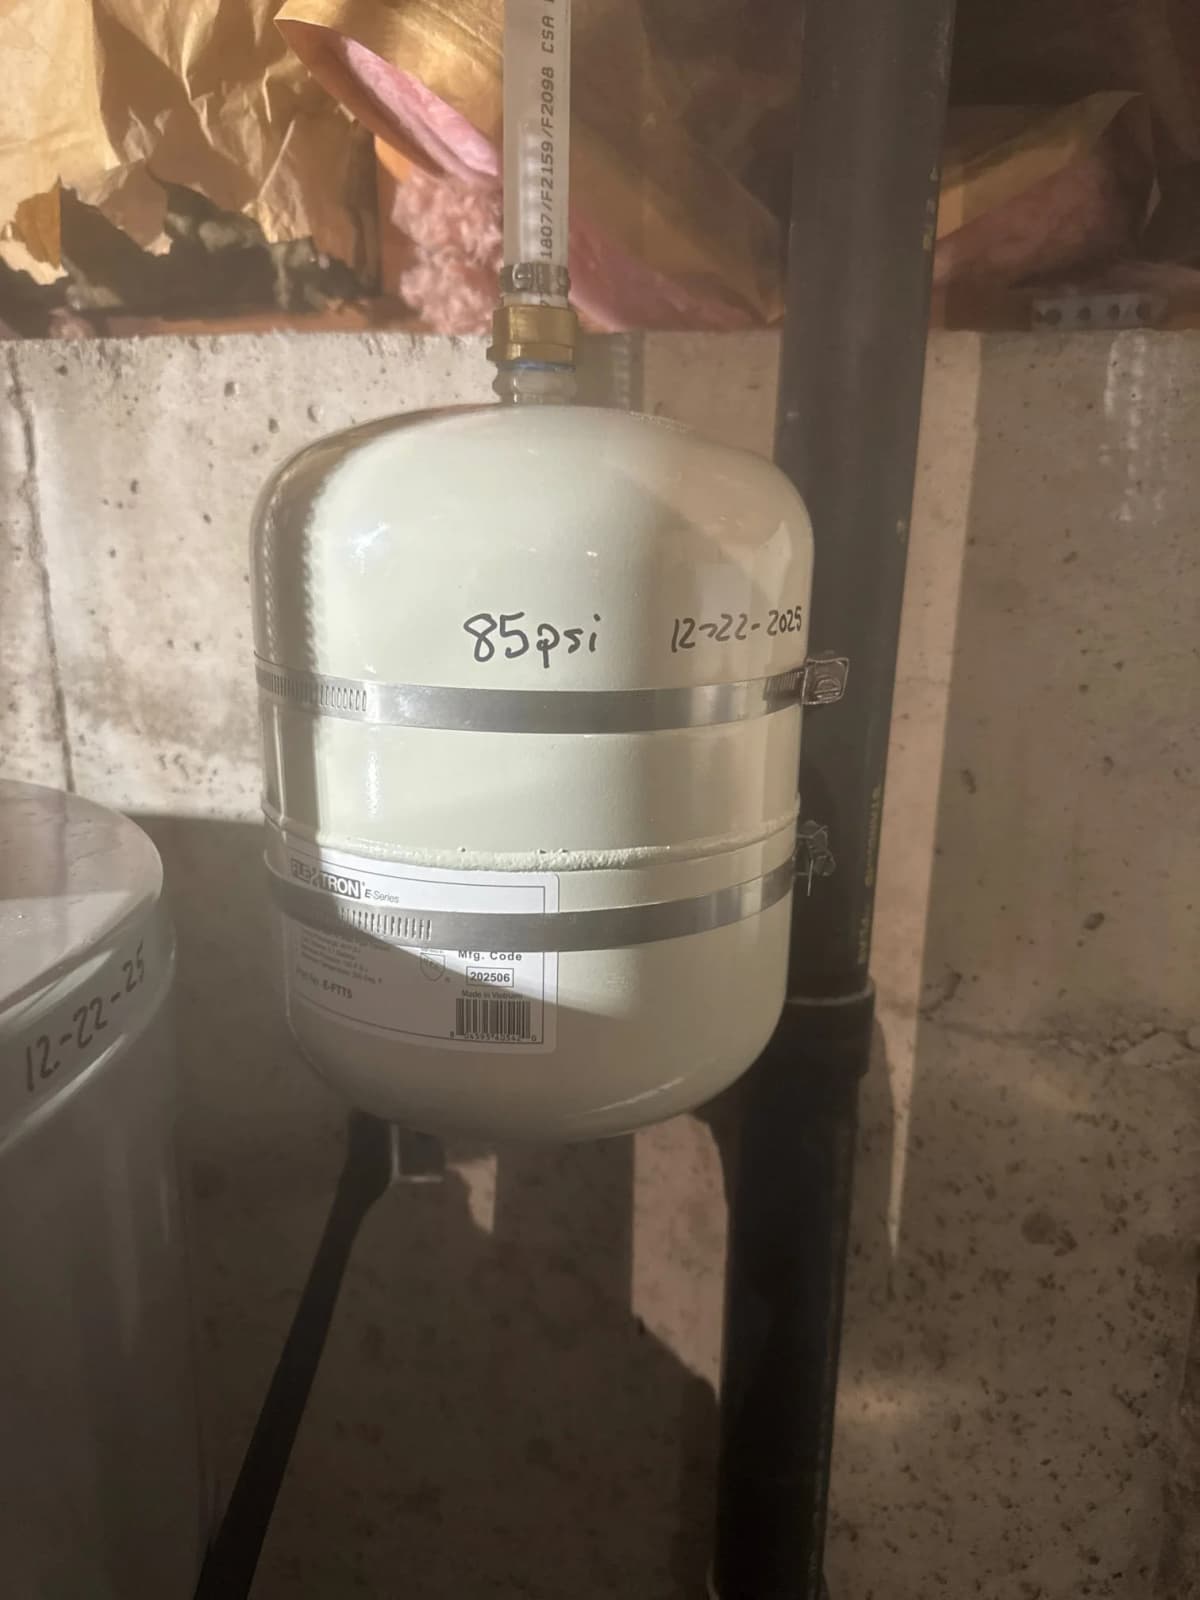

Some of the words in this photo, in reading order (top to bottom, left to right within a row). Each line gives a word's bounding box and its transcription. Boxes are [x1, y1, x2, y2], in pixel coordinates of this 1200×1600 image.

[541, 15, 555, 54] CSA
[489, 952, 523, 961] Code
[470, 971, 511, 983] 202506
[26, 938, 145, 1092] 12-22-25
